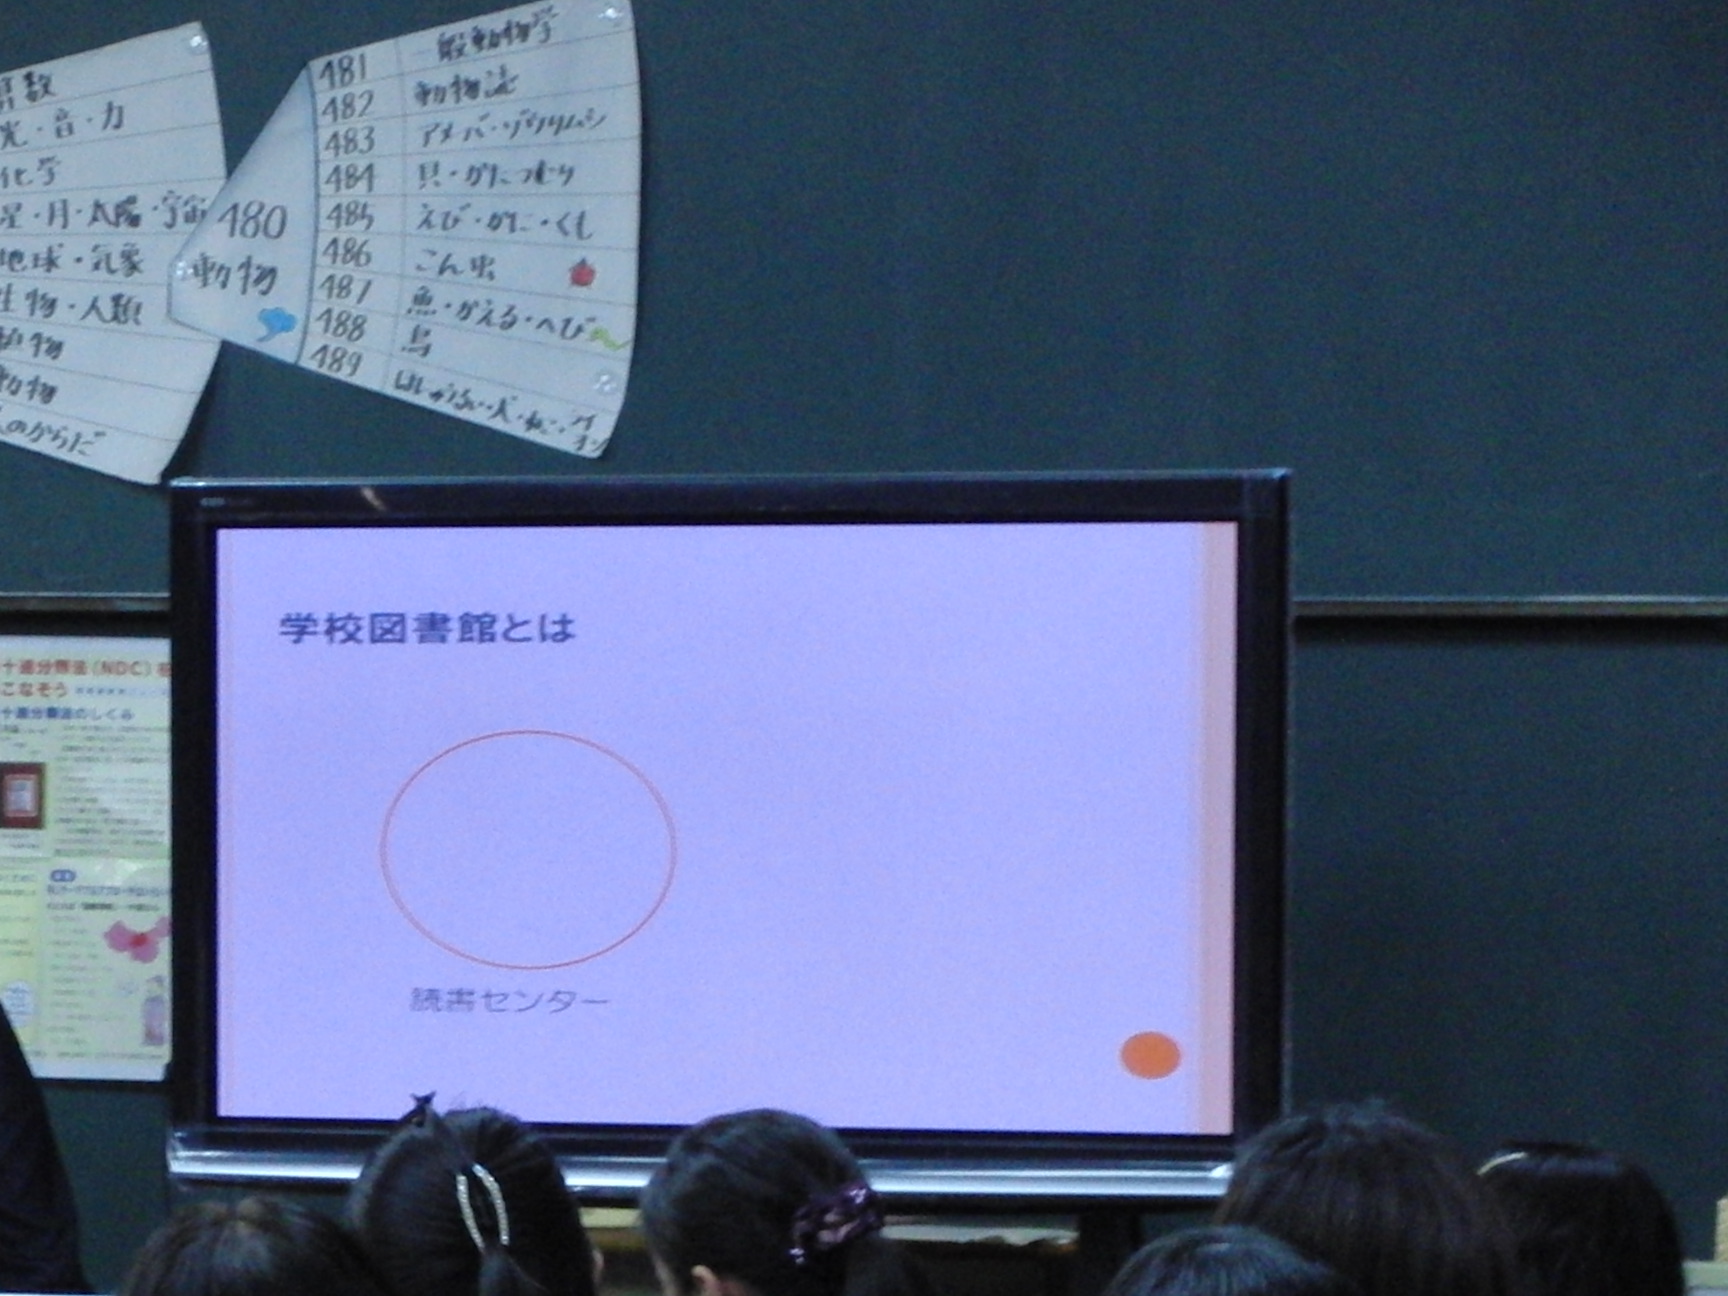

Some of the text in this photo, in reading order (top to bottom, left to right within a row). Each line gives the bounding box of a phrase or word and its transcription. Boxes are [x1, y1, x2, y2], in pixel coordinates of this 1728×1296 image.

[318, 55, 368, 91] 481
[322, 91, 375, 123] 482
[324, 126, 376, 158] 483
[1, 156, 62, 187] 化学
[324, 162, 376, 194] 484
[218, 201, 287, 240] 480
[325, 201, 374, 230] 485
[321, 236, 372, 267] 486
[193, 252, 278, 296] 動物
[319, 272, 372, 304] 487
[315, 306, 366, 342] 488
[310, 343, 363, 377] 489
[278, 611, 576, 646] 学校図書館とは
[409, 986, 609, 1015] 読書センター
